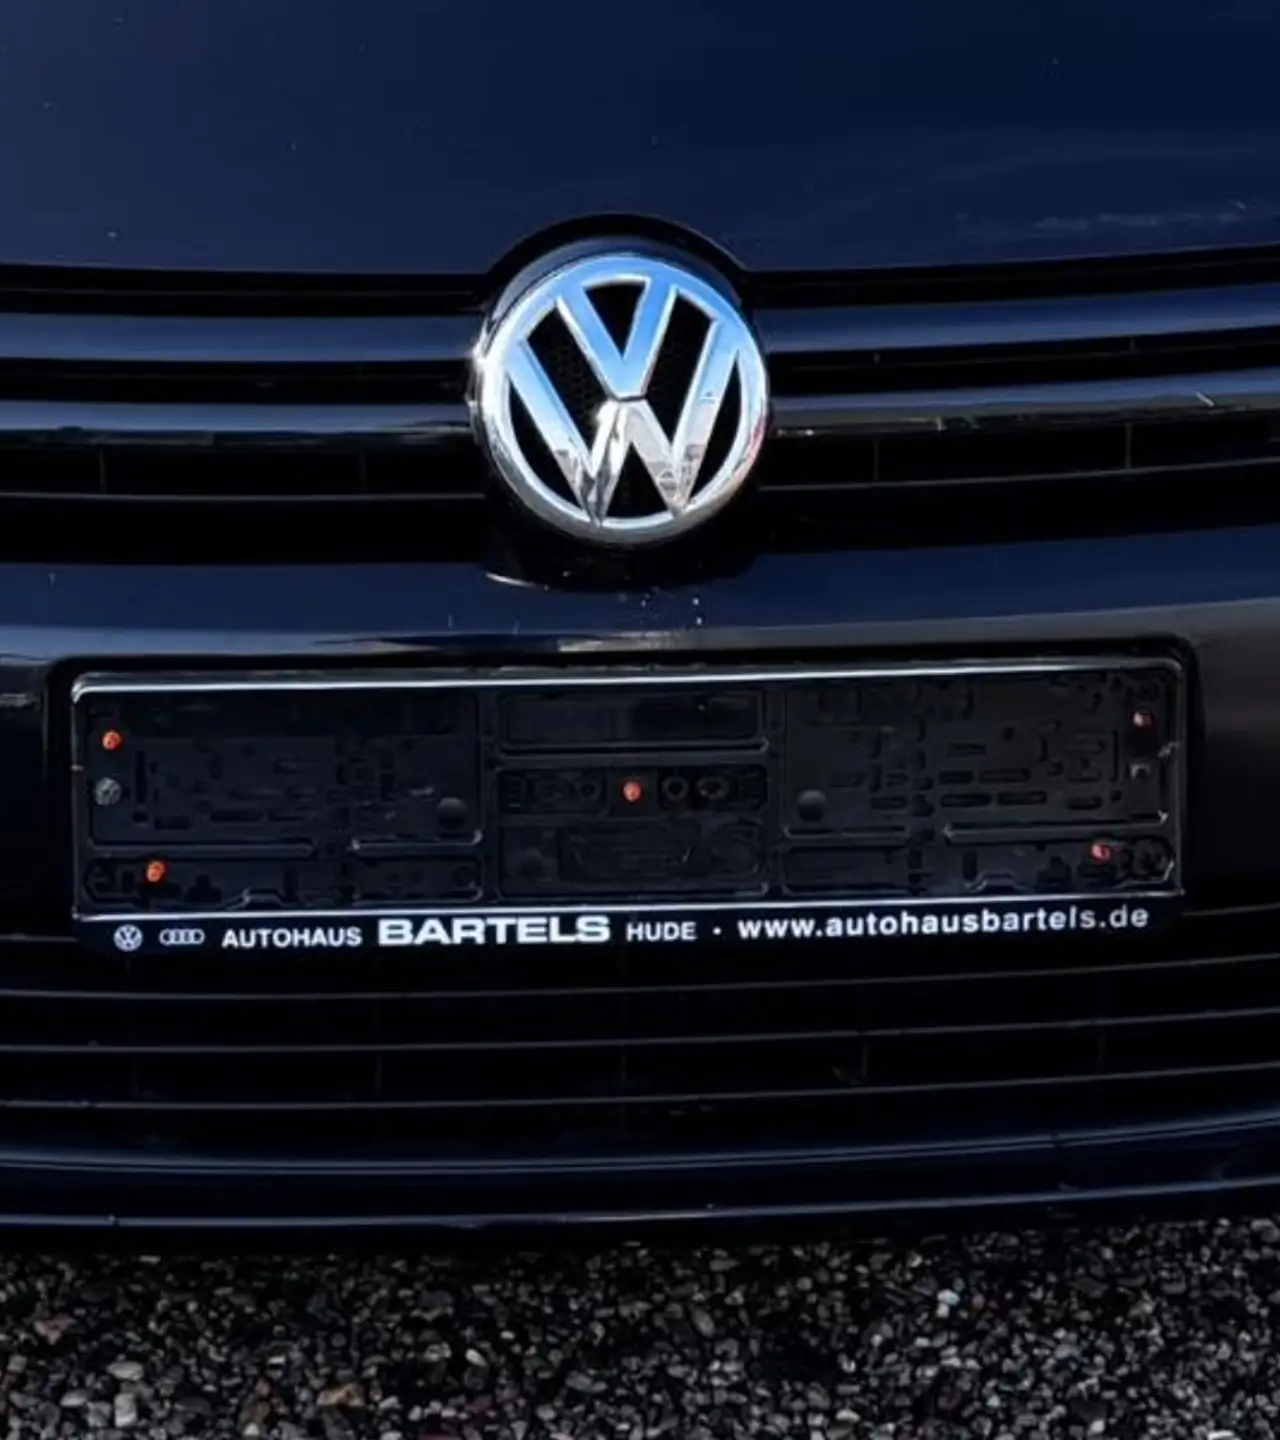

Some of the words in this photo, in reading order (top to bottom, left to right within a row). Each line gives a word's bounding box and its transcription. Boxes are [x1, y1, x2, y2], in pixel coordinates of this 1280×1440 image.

[221, 926, 363, 949] AUTOHAUS
[376, 914, 612, 947] BARTELS
[625, 920, 698, 942] HUDE
[737, 904, 1149, 940] www.autohausbartels.de
